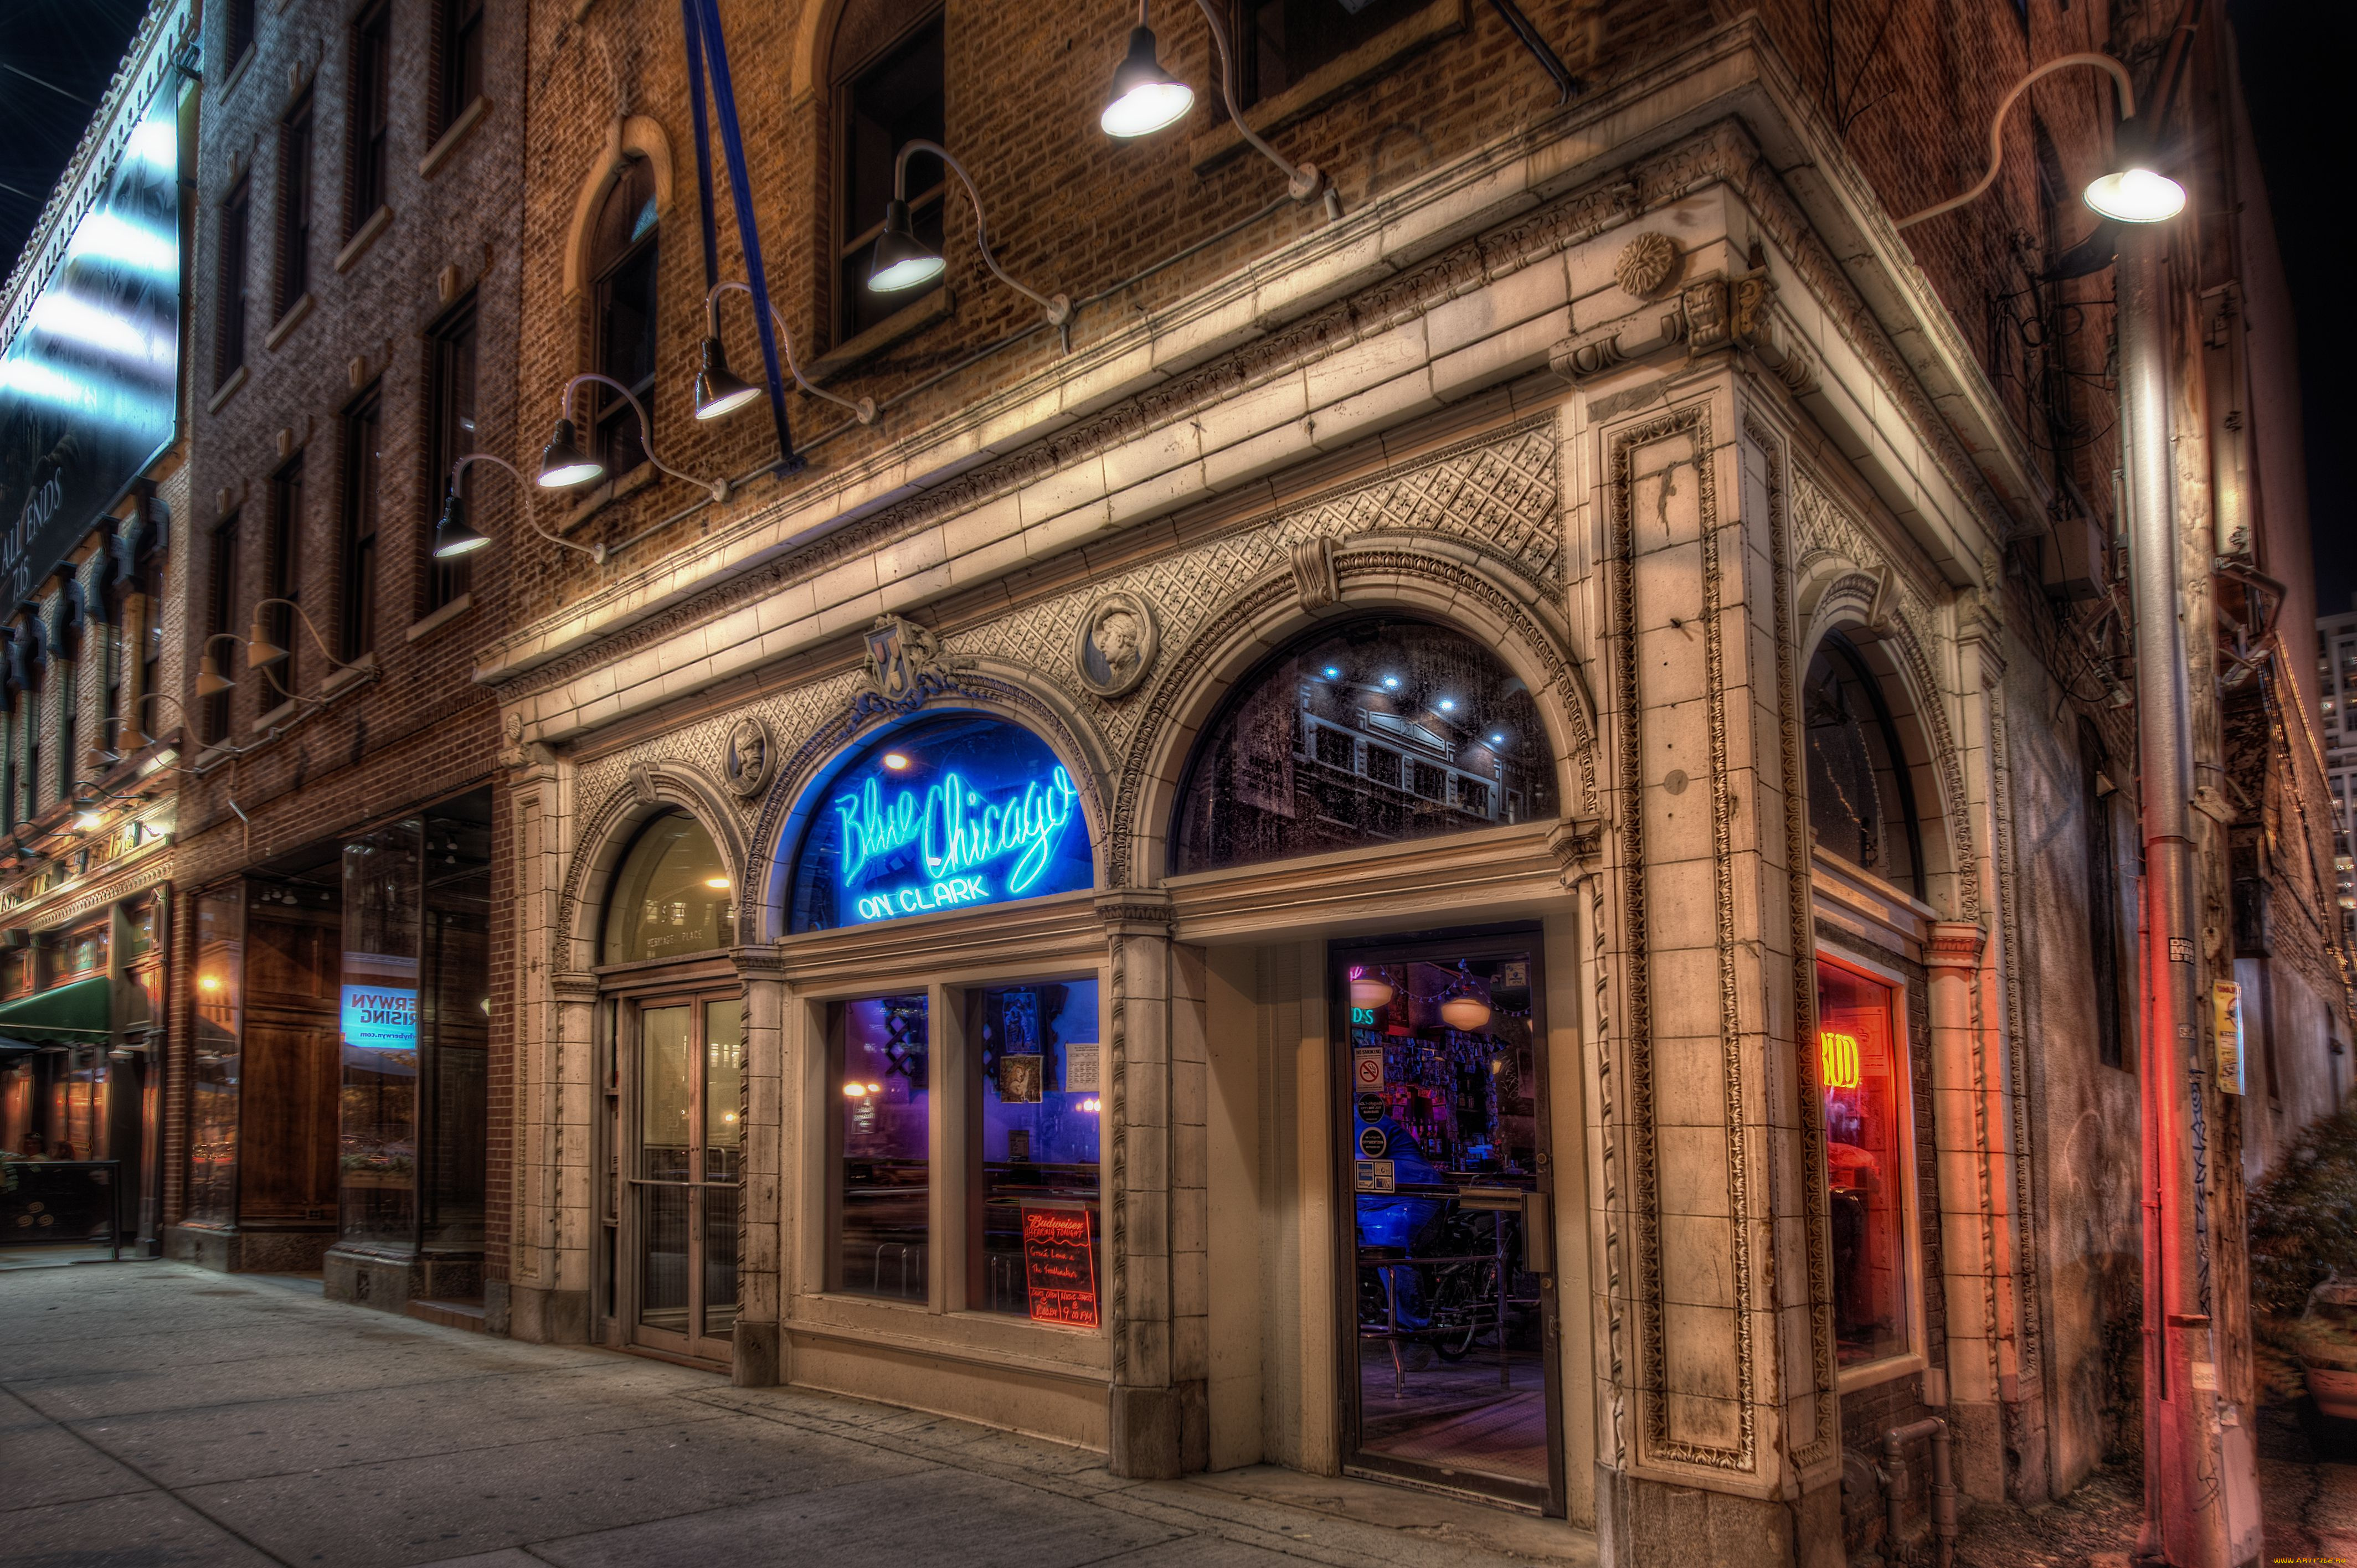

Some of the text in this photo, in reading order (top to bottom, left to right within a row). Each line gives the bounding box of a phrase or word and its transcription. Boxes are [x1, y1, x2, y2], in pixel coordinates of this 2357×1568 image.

[1, 467, 62, 577] ALL ENDS
[835, 765, 1078, 893] Blue Chicago
[858, 874, 990, 920] ON CLARK
[682, 930, 702, 941] PLACE
[1027, 1214, 1084, 1230] Budweiser
[1056, 1228, 1084, 1239] TONIGHT
[1061, 1292, 1077, 1301] MUSIC
[1080, 1311, 1093, 1321] PM
